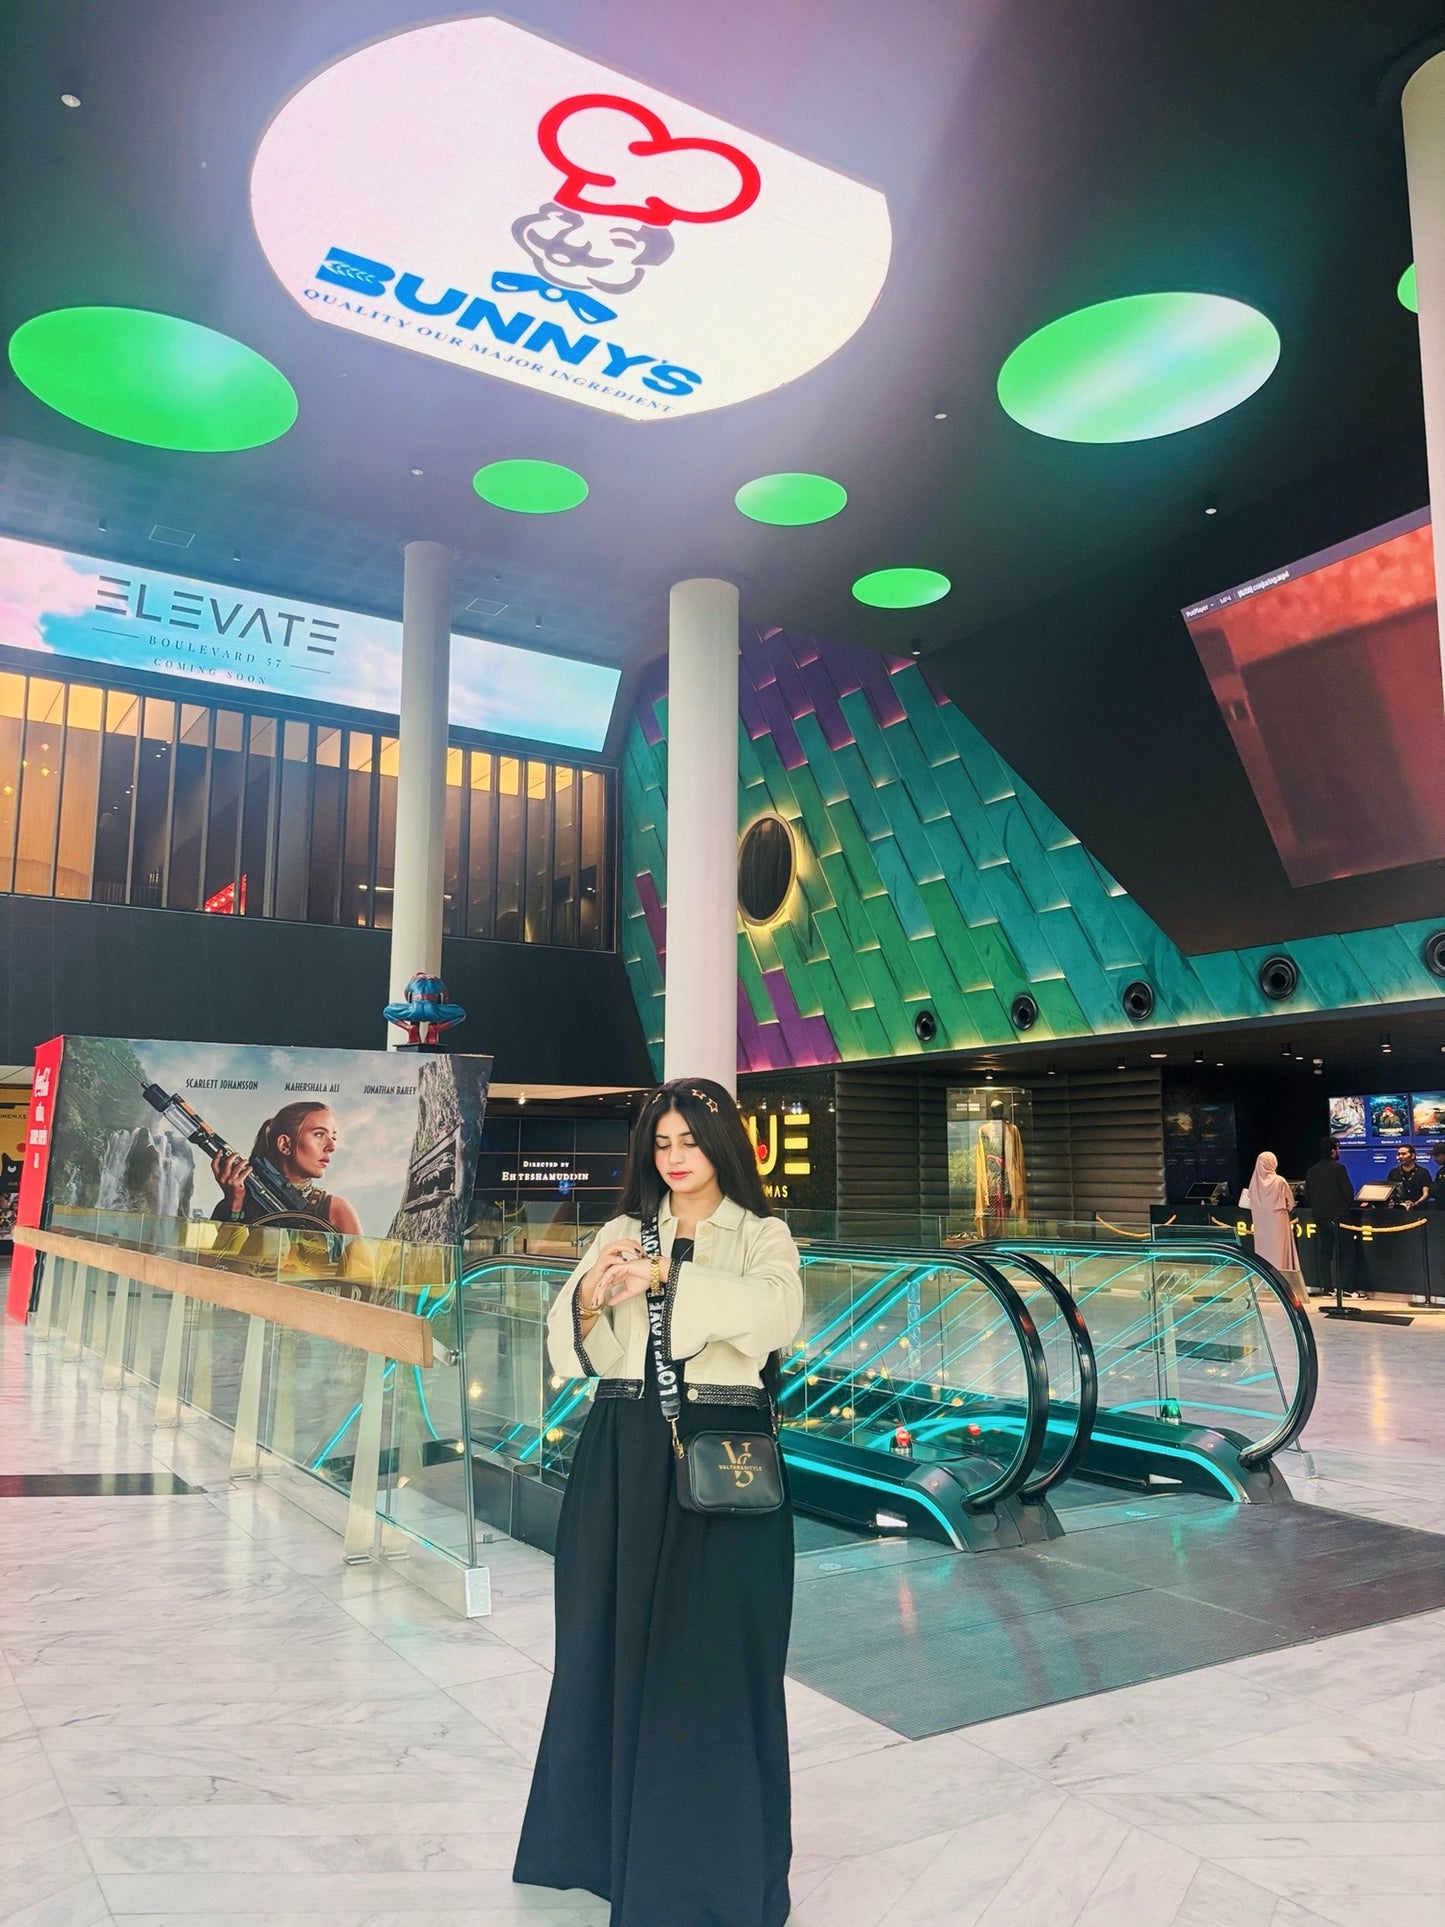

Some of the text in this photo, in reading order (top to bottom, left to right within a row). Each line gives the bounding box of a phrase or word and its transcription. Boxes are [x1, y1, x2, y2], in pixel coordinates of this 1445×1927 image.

[315, 246, 703, 396] BUNNY'S
[304, 288, 675, 413] QUALITY OUR MAJOR INGREDIENT
[95, 575, 340, 656] ELEVATE
[149, 635, 256, 664] BOULEVARD
[153, 657, 267, 685] COMING SOON
[185, 1078, 259, 1091] SCARLETT JOHANSSON
[284, 1082, 340, 1093] MAHERSHALA ALI
[363, 1084, 417, 1096] JONATHAN BAILEY
[741, 1113, 811, 1176] UE
